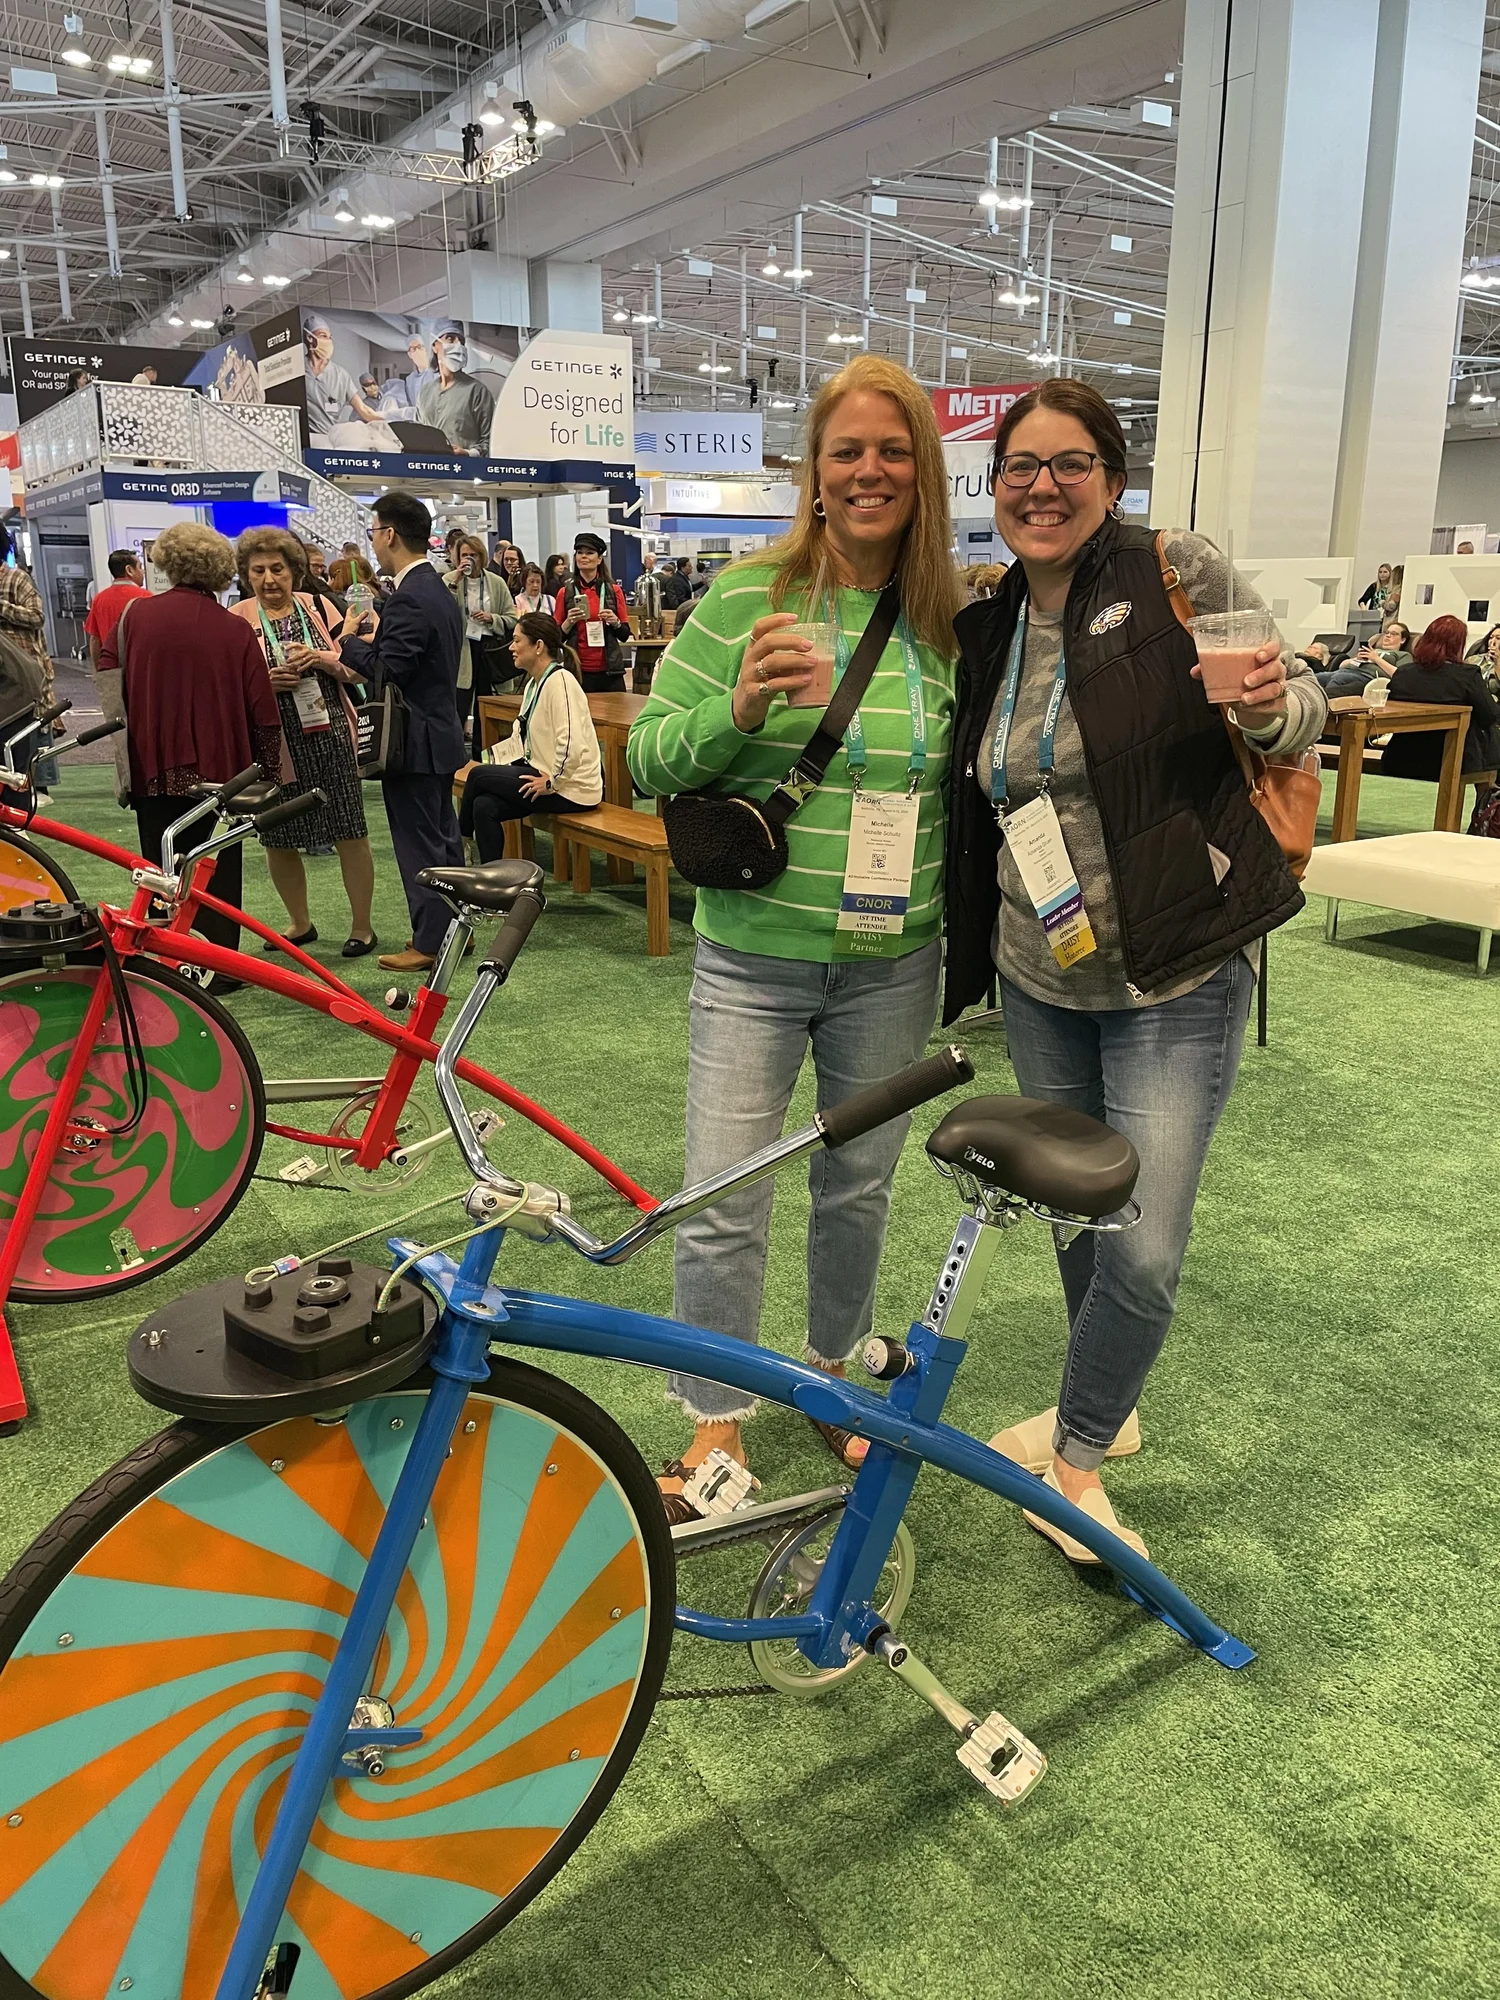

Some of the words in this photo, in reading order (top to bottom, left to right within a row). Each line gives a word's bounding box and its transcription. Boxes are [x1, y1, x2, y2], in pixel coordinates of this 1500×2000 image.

[24, 353, 87, 365] GETINGE
[32, 369, 52, 379] Your
[53, 373, 70, 381] part
[531, 360, 603, 375] GETINGE
[22, 380, 36, 389] OR
[37, 382, 53, 390] and
[54, 382, 67, 390] SP
[523, 386, 623, 417] Designed
[550, 421, 579, 444] for
[585, 424, 625, 447] Life
[664, 432, 752, 454] STERIS
[324, 457, 370, 467] GETINGE
[407, 462, 450, 471] GETINGE
[487, 466, 527, 475] GETINGE
[122, 482, 167, 493] GETING
[170, 482, 200, 497] OR3D
[1055, 678, 1065, 703] ONE
[910, 688, 918, 710] TRAY
[1049, 702, 1060, 736] TRAY
[912, 717, 920, 739] ONE
[995, 716, 1006, 743] TRAY
[993, 743, 1002, 769] ONE
[1028, 832, 1046, 845] Amanda
[856, 897, 893, 910] CNOR
[853, 931, 885, 941] DAISY
[1061, 932, 1081, 951] DAISY
[850, 942, 884, 953] Partner
